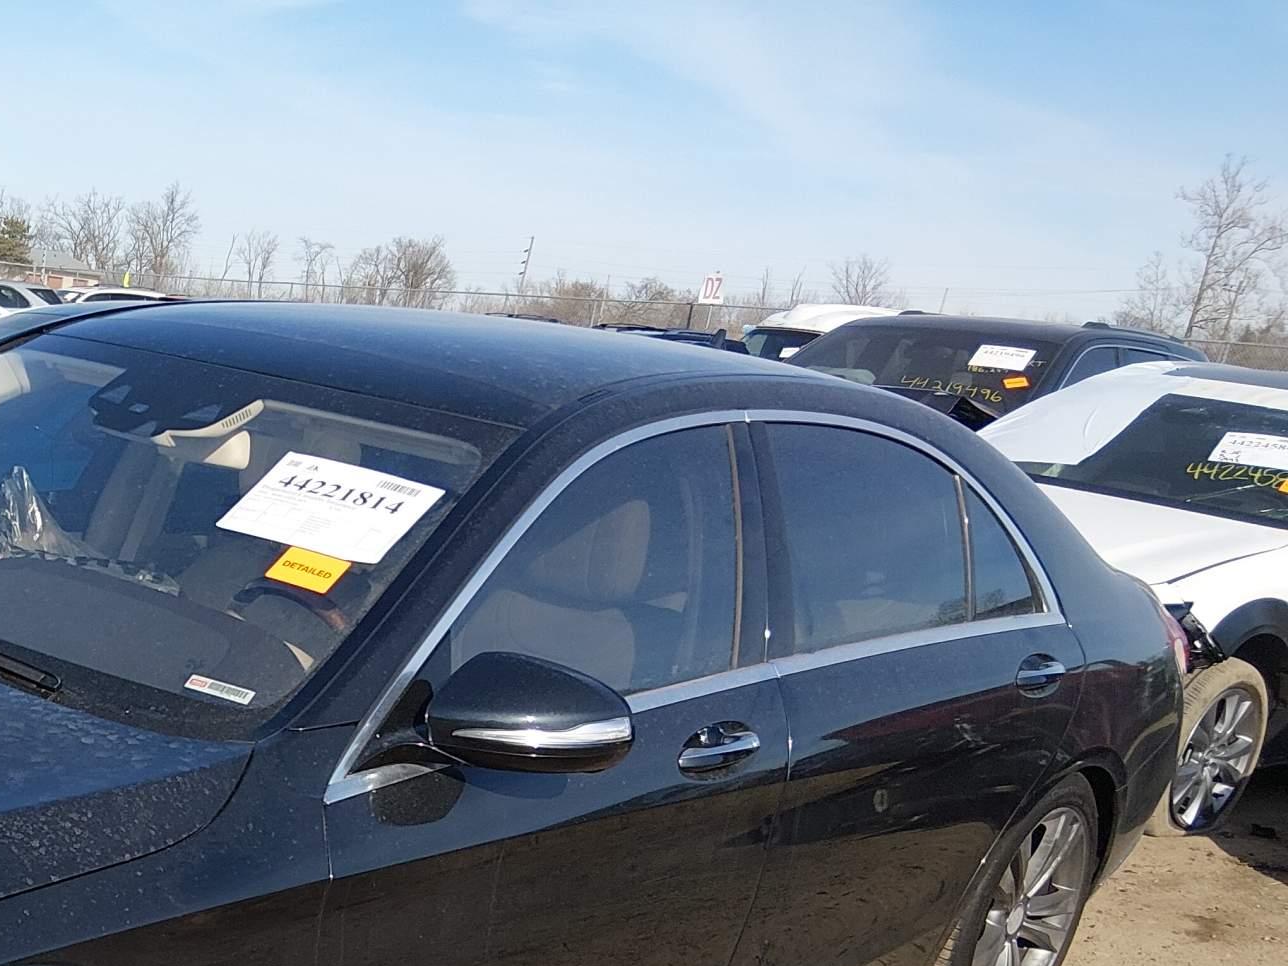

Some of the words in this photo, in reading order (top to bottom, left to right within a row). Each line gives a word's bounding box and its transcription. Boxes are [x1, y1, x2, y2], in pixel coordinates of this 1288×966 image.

[900, 375, 1002, 403] 44219496
[278, 474, 406, 514] 44221814
[282, 559, 333, 580] DETAILED
